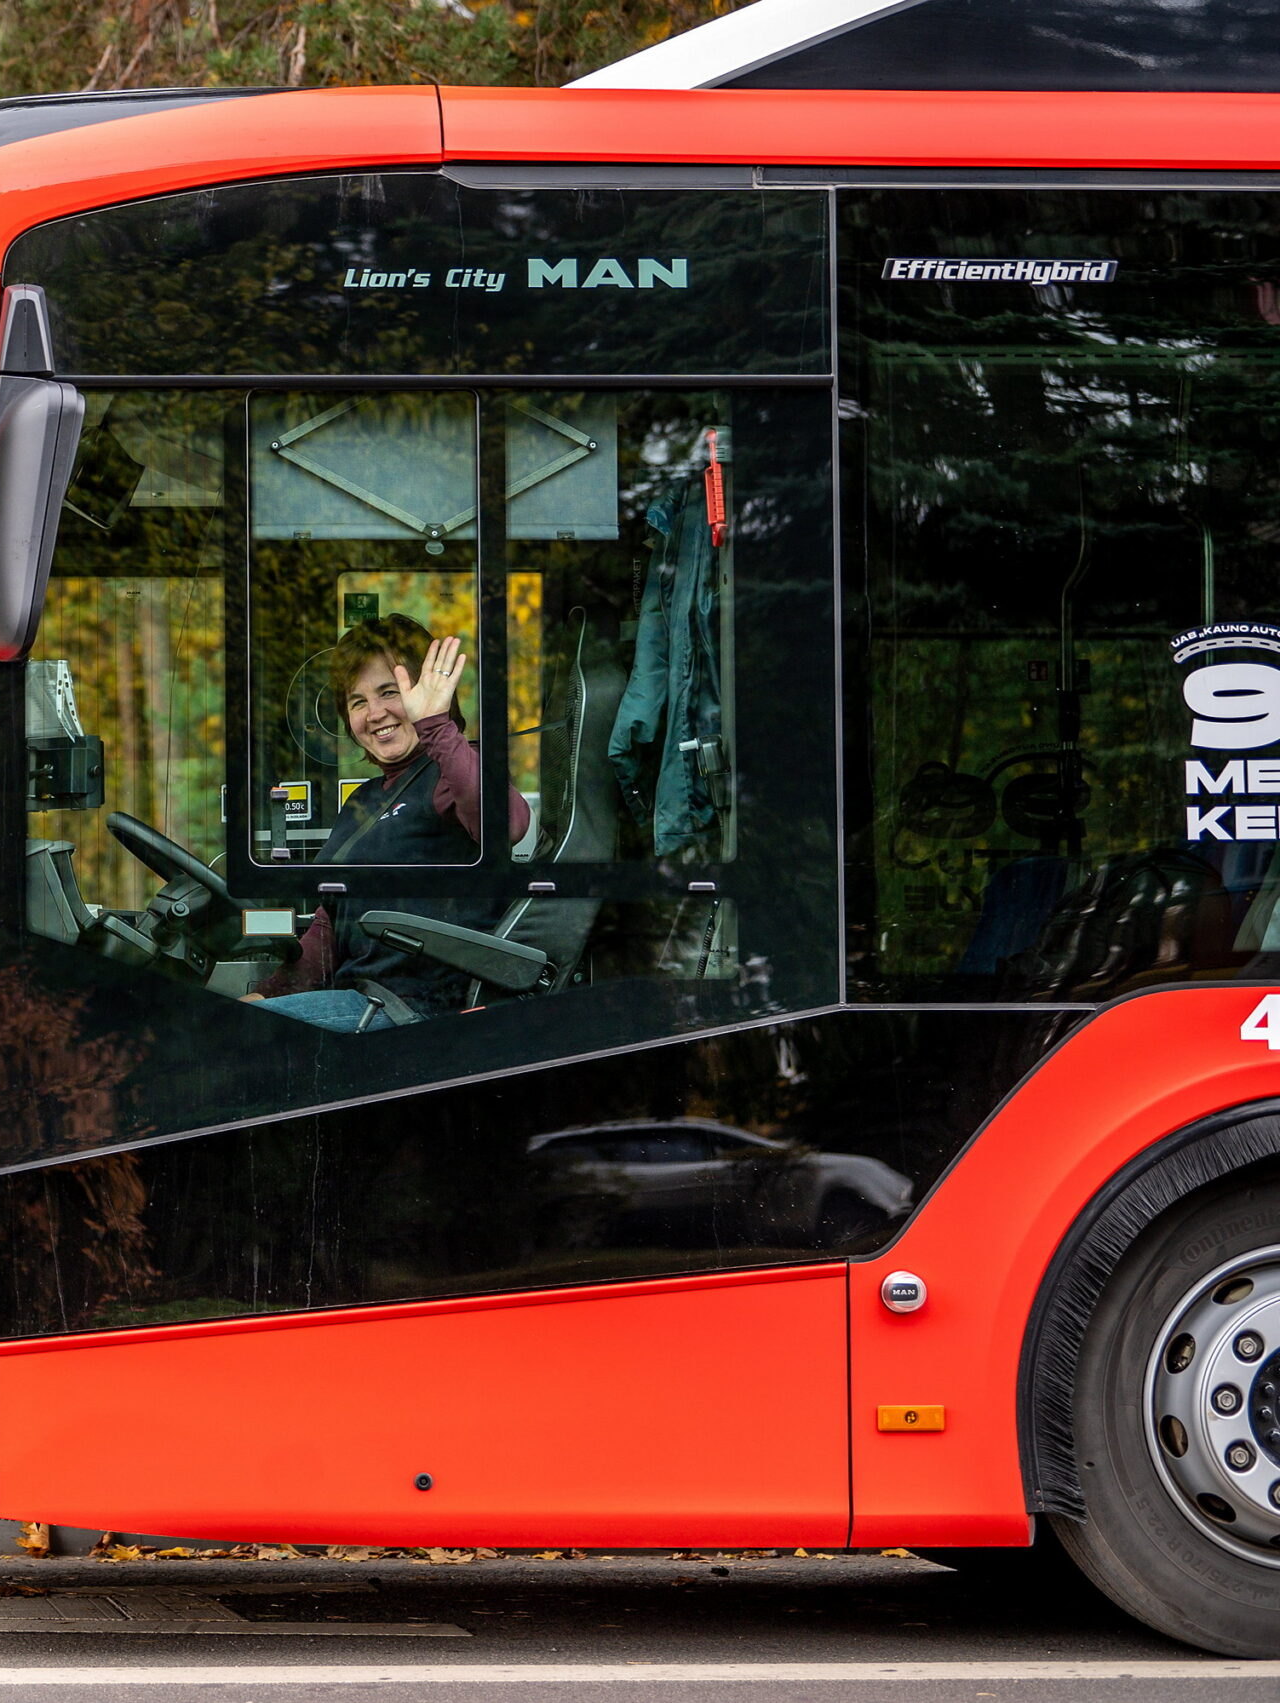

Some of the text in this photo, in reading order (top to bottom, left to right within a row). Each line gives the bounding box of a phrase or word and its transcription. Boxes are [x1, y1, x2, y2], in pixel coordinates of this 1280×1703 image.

[344, 268, 506, 292] Lion's City
[527, 258, 688, 288] MAN
[890, 260, 1109, 285] EfficientHybrid
[1171, 631, 1197, 648] UAB
[1183, 663, 1280, 749] 9
[1187, 806, 1280, 840] KE
[1240, 993, 1280, 1050] 4
